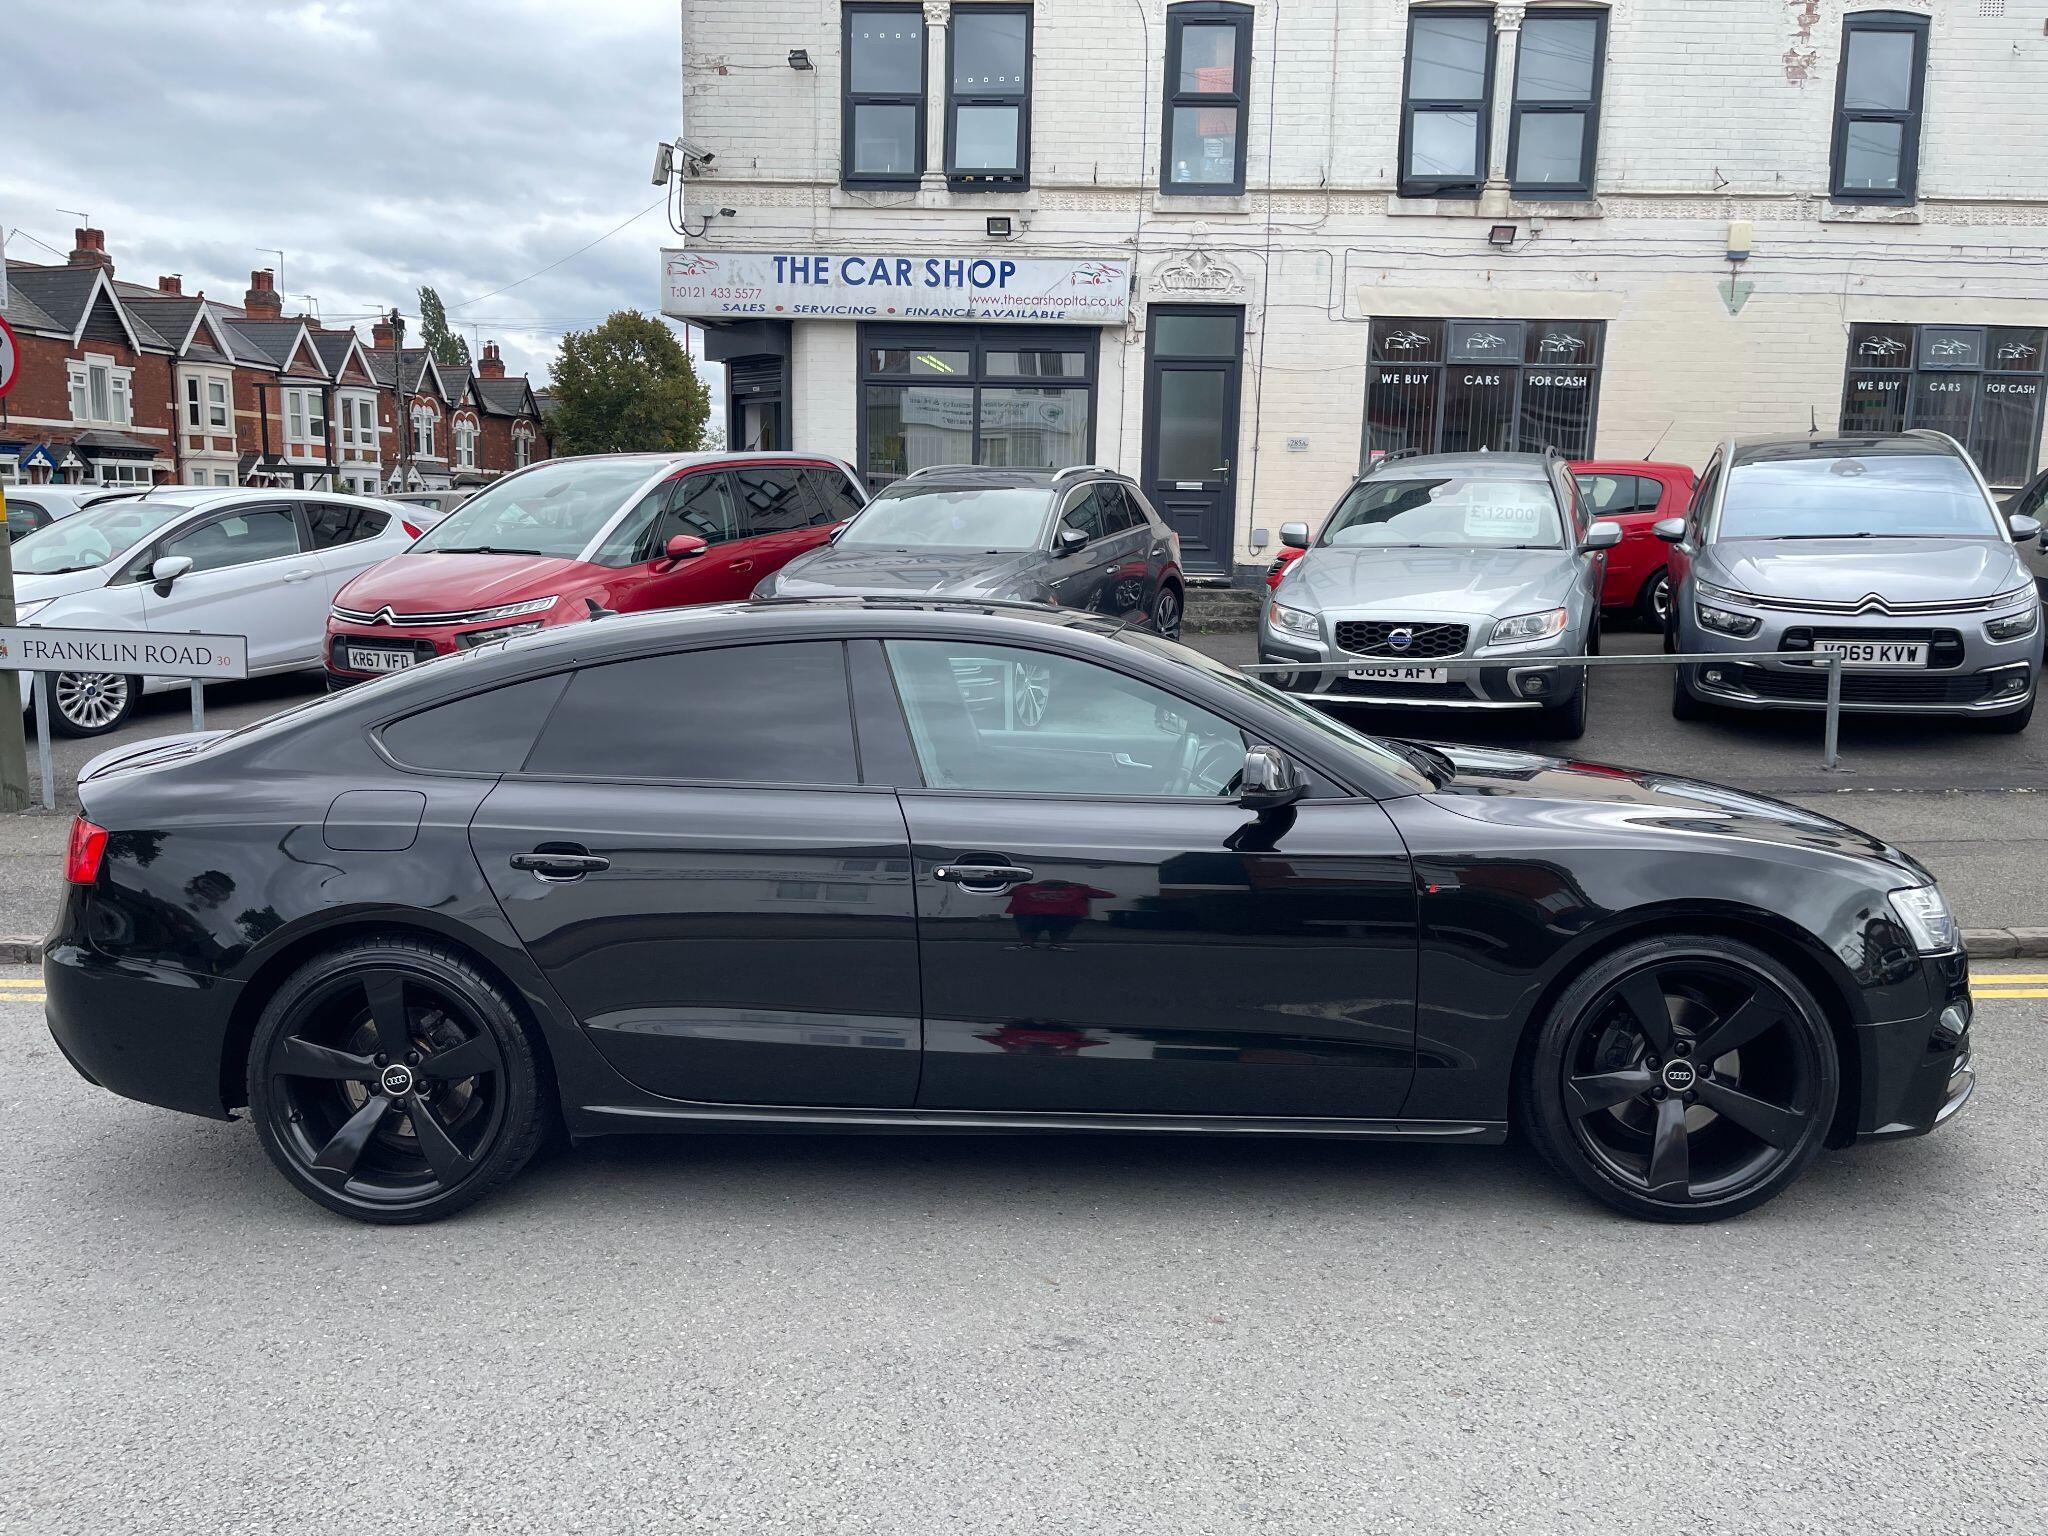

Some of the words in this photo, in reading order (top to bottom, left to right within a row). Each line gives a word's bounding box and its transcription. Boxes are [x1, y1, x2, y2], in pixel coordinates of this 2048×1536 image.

[773, 256, 829, 285] THE
[841, 257, 912, 287] CAR
[924, 258, 1016, 289] SHOP
[670, 286, 706, 298] T:0121
[711, 287, 731, 299] 433
[734, 288, 763, 300] 5577
[968, 294, 1125, 309] www.thecarshopltd.co.uk
[721, 303, 766, 312] SALES
[793, 304, 878, 315] SERVICING
[905, 307, 976, 318] FINANCE
[981, 309, 1066, 319] AVAILABLE
[1381, 373, 1400, 384] WE
[1404, 373, 1430, 385] BUY
[1463, 375, 1501, 386] CARS
[1529, 375, 1552, 386] FOR
[1554, 376, 1588, 387] CASH
[1857, 381, 1874, 390] WE
[1878, 381, 1900, 390] BUY
[1929, 382, 1962, 392] CARS
[1986, 383, 2007, 393] FOR
[2008, 384, 2036, 394] CASH
[23, 640, 138, 663] FRANKLIN
[145, 645, 212, 666] ROAD
[217, 655, 231, 667] 30
[1880, 645, 1918, 662] KVW
[352, 651, 380, 668] KR67
[383, 652, 409, 672] VFD
[1404, 667, 1438, 680] AFY
